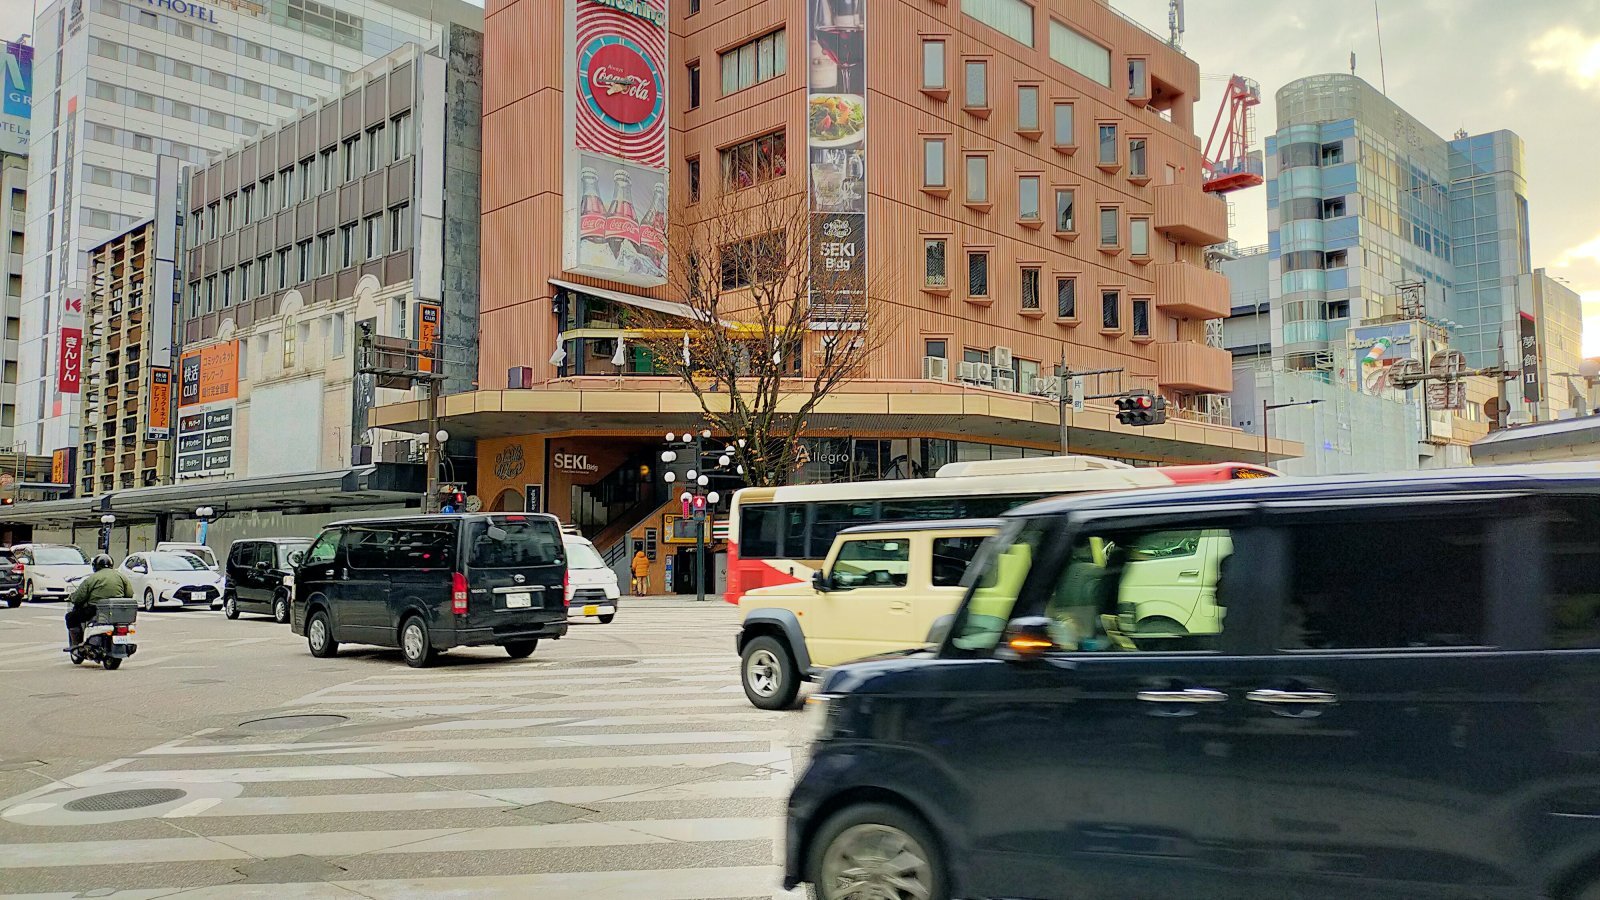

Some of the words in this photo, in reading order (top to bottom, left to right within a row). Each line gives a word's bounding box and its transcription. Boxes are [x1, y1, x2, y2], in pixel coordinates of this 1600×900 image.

[157, 0, 218, 24] HOTEL
[820, 242, 855, 257] SEKI
[825, 257, 851, 271] Bldg
[63, 336, 78, 382] きんしん
[183, 363, 199, 383] 快活
[202, 368, 224, 382] テレワーク
[183, 384, 198, 398] CLUB
[553, 452, 587, 470] SEKI
[586, 463, 599, 472] Bldg
[795, 444, 849, 465] Allegro
